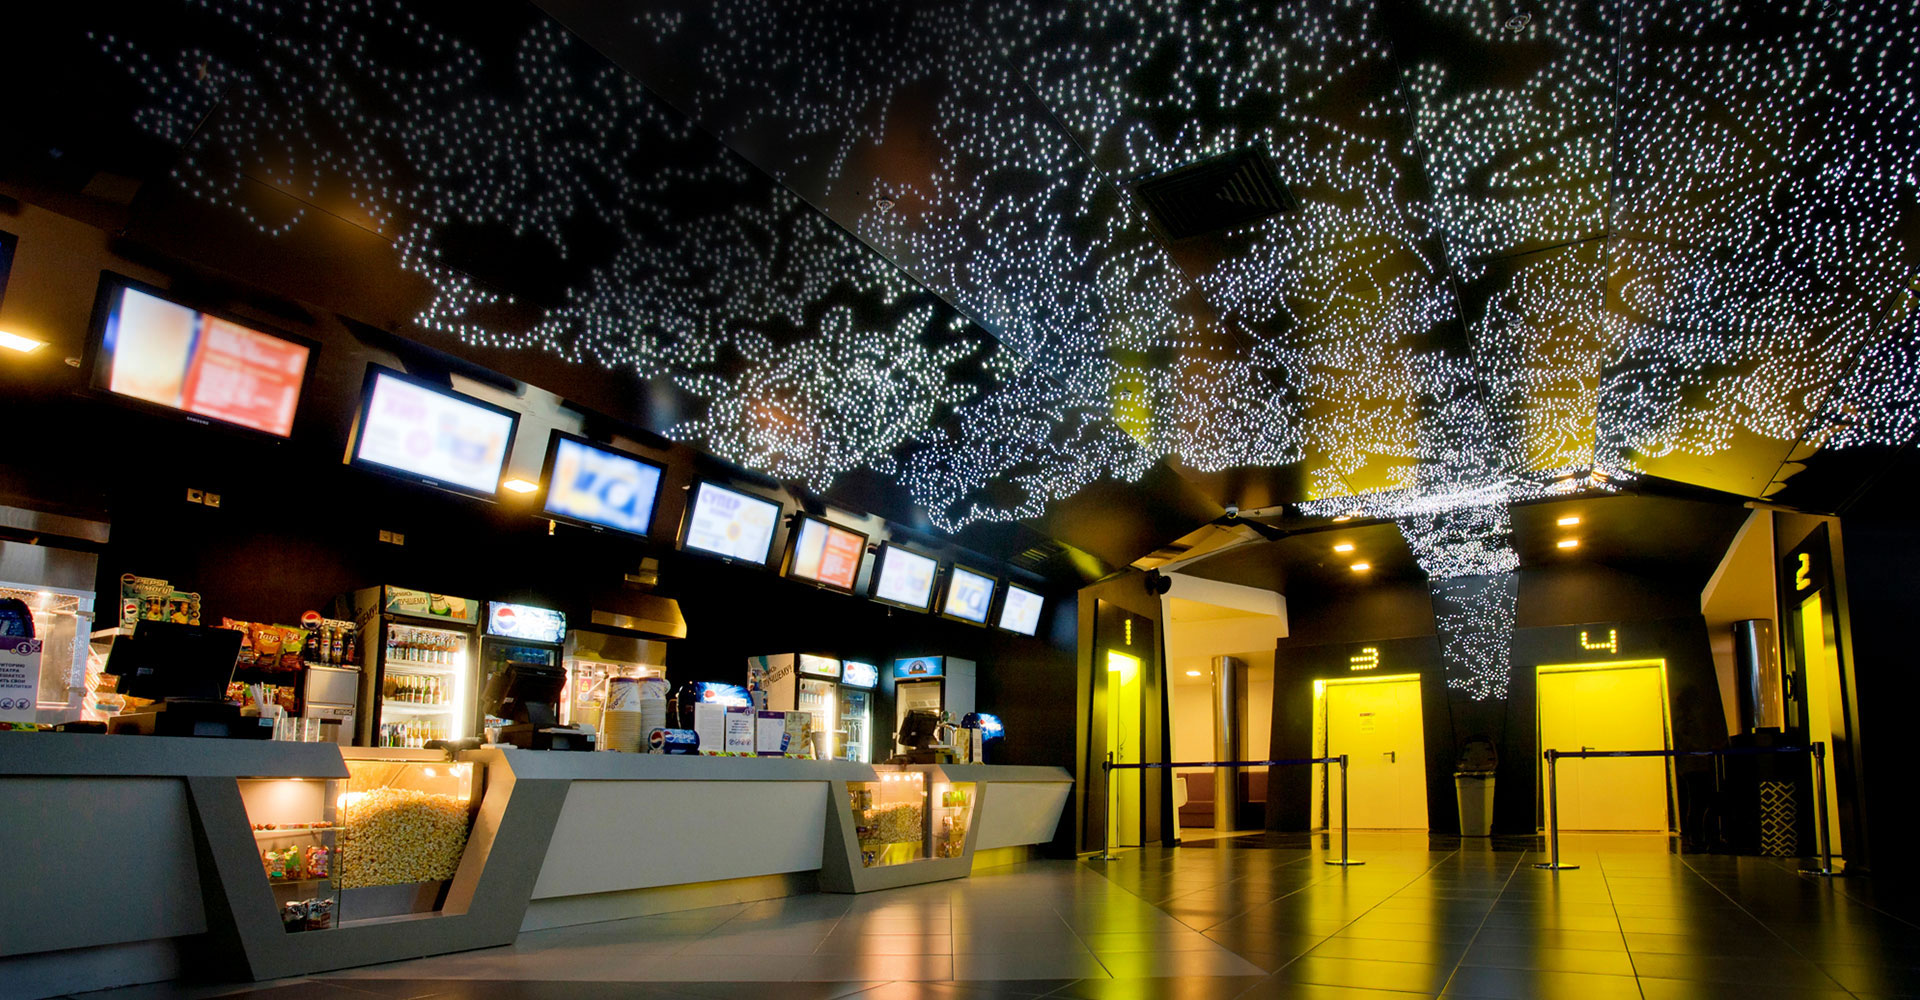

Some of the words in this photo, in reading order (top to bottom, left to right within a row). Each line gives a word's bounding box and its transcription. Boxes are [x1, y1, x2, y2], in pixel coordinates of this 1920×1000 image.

[1796, 553, 1811, 591] 2
[322, 618, 357, 630] PEPSI
[1125, 619, 1132, 646] 1
[1580, 629, 1618, 654] 4
[1350, 647, 1379, 671] 3
